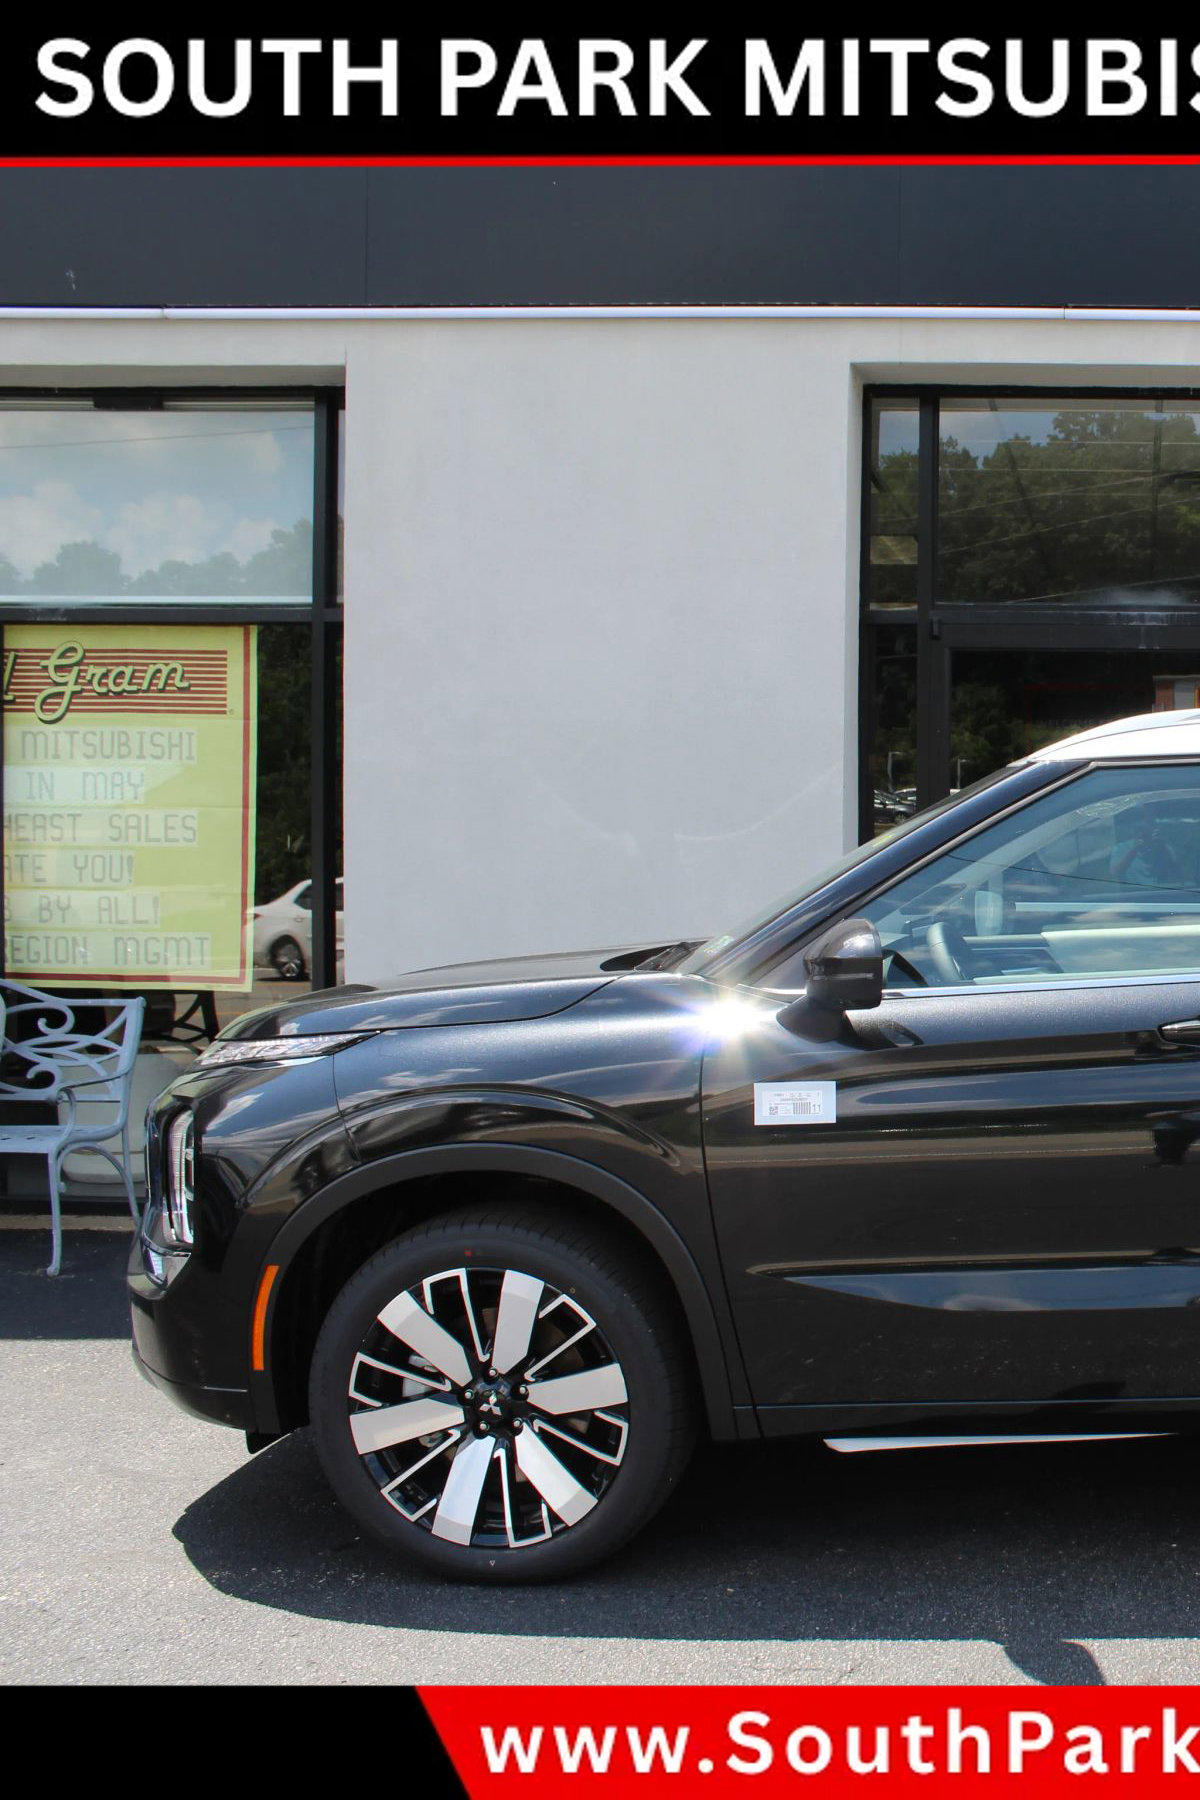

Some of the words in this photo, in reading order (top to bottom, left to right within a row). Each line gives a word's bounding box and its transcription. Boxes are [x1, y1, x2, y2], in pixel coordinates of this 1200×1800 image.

[34, 640, 191, 724] Gram
[21, 730, 195, 761] MITSUBISHI
[26, 771, 54, 800] IN
[82, 772, 145, 800] MAY
[109, 814, 197, 843] SALES
[73, 854, 133, 883] YOU!
[38, 895, 71, 923] BY
[98, 896, 160, 924] ALL!
[4, 935, 88, 965] EGION
[114, 936, 209, 966] MGMT
